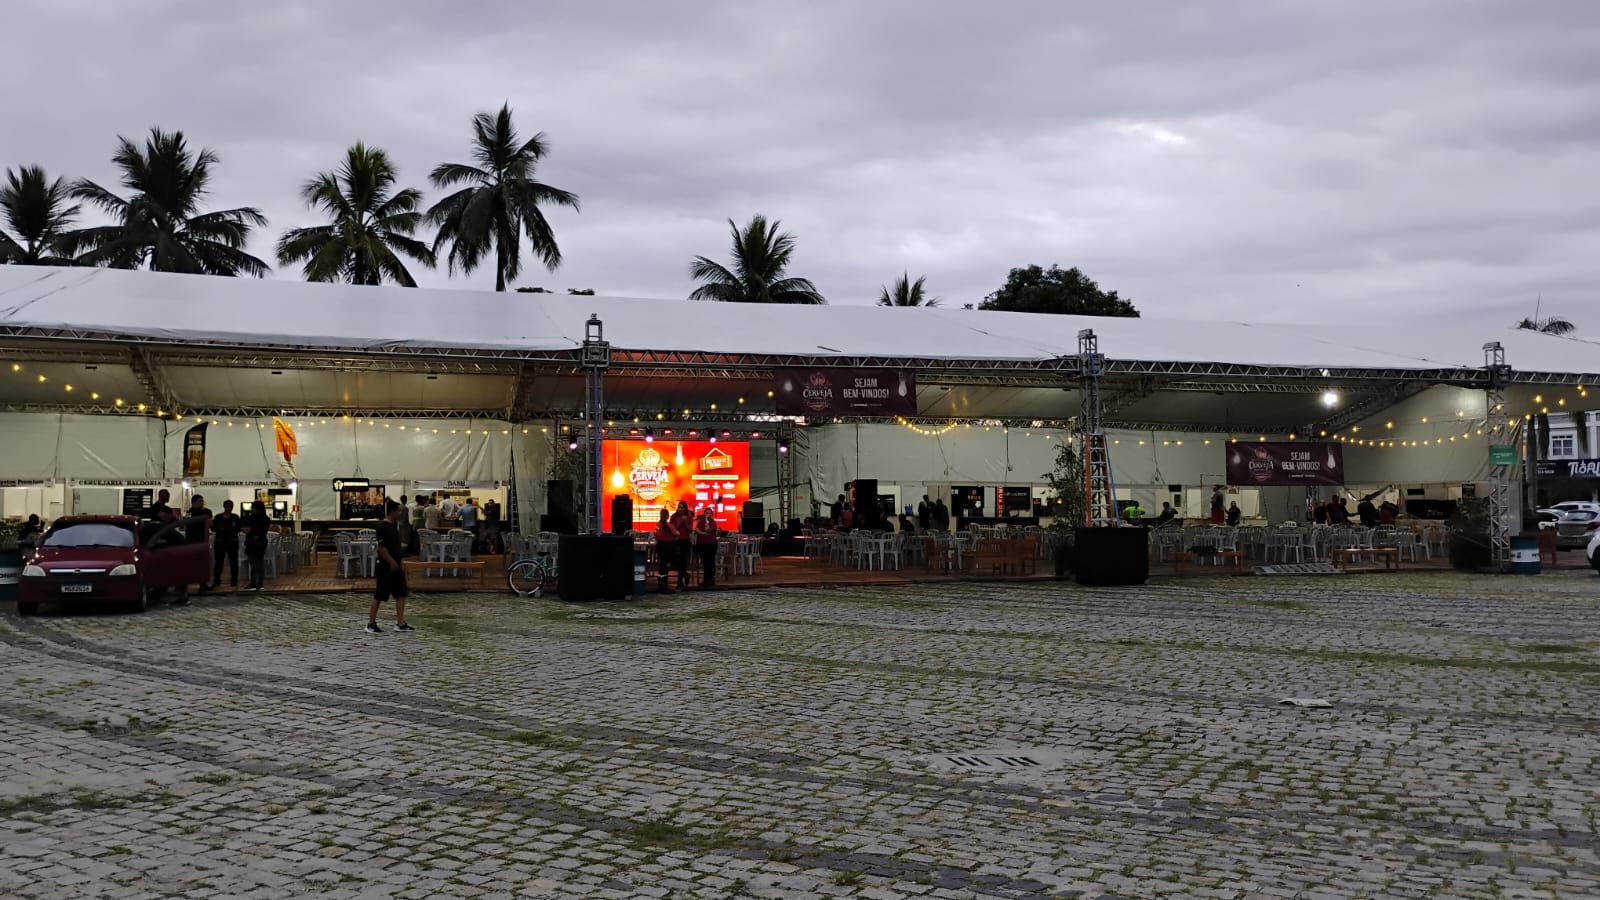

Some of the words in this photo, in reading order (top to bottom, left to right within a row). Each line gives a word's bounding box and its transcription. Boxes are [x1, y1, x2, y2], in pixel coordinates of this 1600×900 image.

[854, 378, 878, 388] SEJAM
[802, 387, 833, 399] CERVEJA
[843, 389, 890, 399] BEM-VINDOS!
[1290, 452, 1311, 461] SEJAM
[628, 468, 669, 483] CERVEJA
